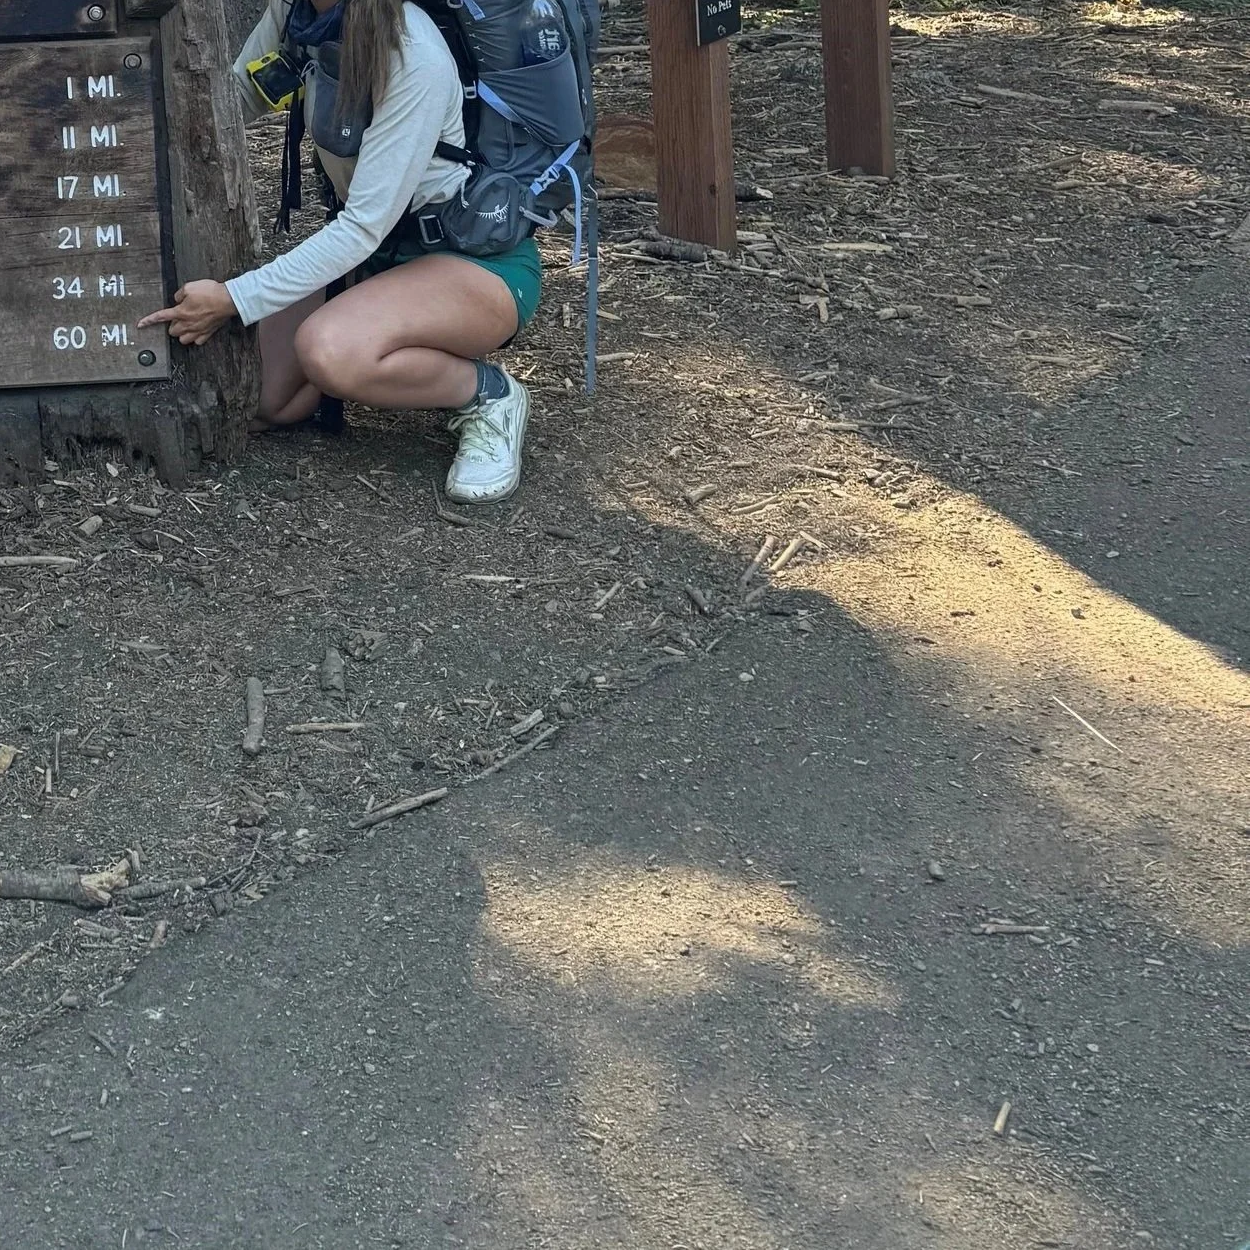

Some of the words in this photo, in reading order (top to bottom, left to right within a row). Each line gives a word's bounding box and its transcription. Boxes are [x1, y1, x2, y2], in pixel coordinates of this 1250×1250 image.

[706, 3, 718, 17] No
[718, 0, 733, 13] Pets
[87, 74, 122, 98] MI.
[90, 124, 125, 148] MI.
[56, 175, 79, 199] 17
[93, 174, 127, 197] MI.
[58, 227, 81, 250] 21
[95, 224, 130, 248] MI.
[52, 276, 83, 299] 34
[98, 274, 133, 298] MI.
[53, 326, 86, 350] 60
[101, 324, 135, 348] MI.
